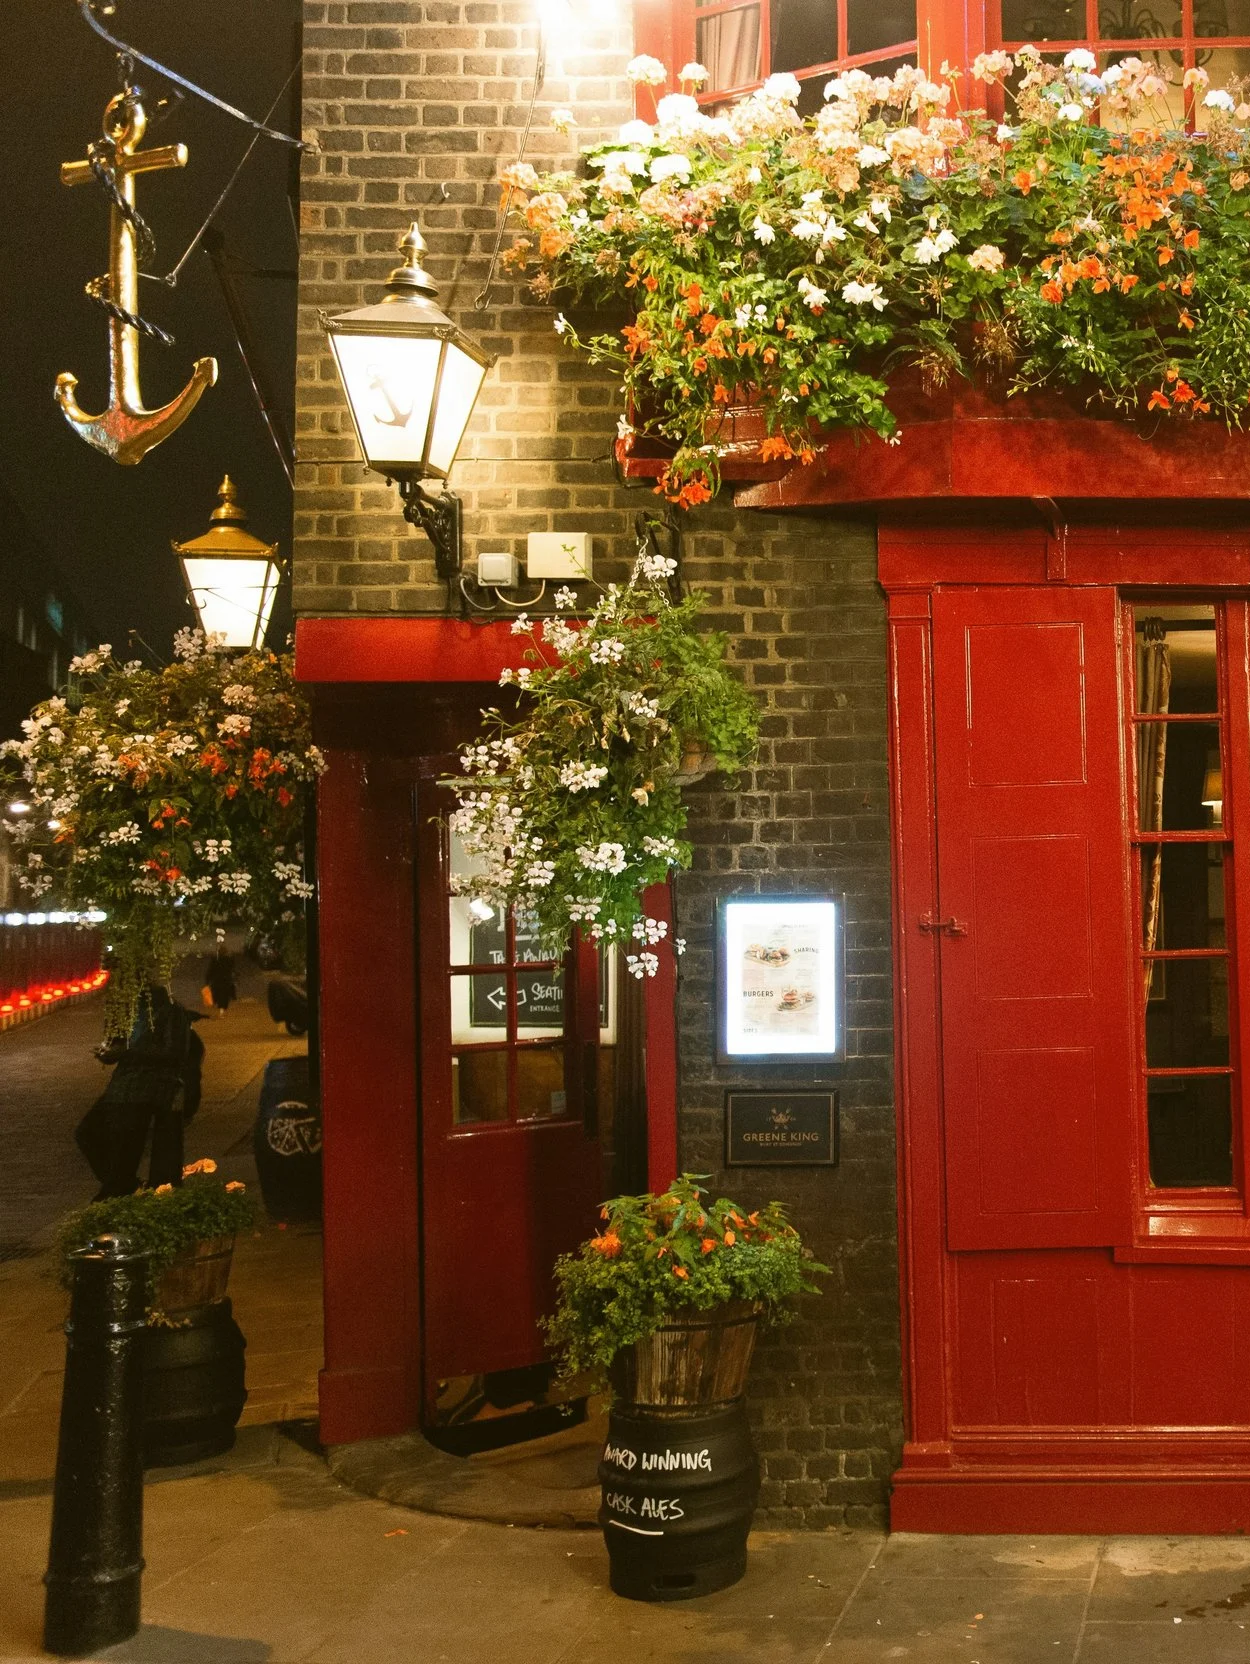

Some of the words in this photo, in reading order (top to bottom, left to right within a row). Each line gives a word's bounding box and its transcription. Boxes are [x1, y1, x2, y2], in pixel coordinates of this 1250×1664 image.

[489, 950, 521, 965] TAE
[531, 982, 563, 1000] SEATI
[743, 1133, 787, 1142] GREENE
[790, 1132, 819, 1141] KING
[641, 1449, 712, 1471] WINNING
[606, 1493, 637, 1515] CASK
[640, 1497, 684, 1521] ALES
